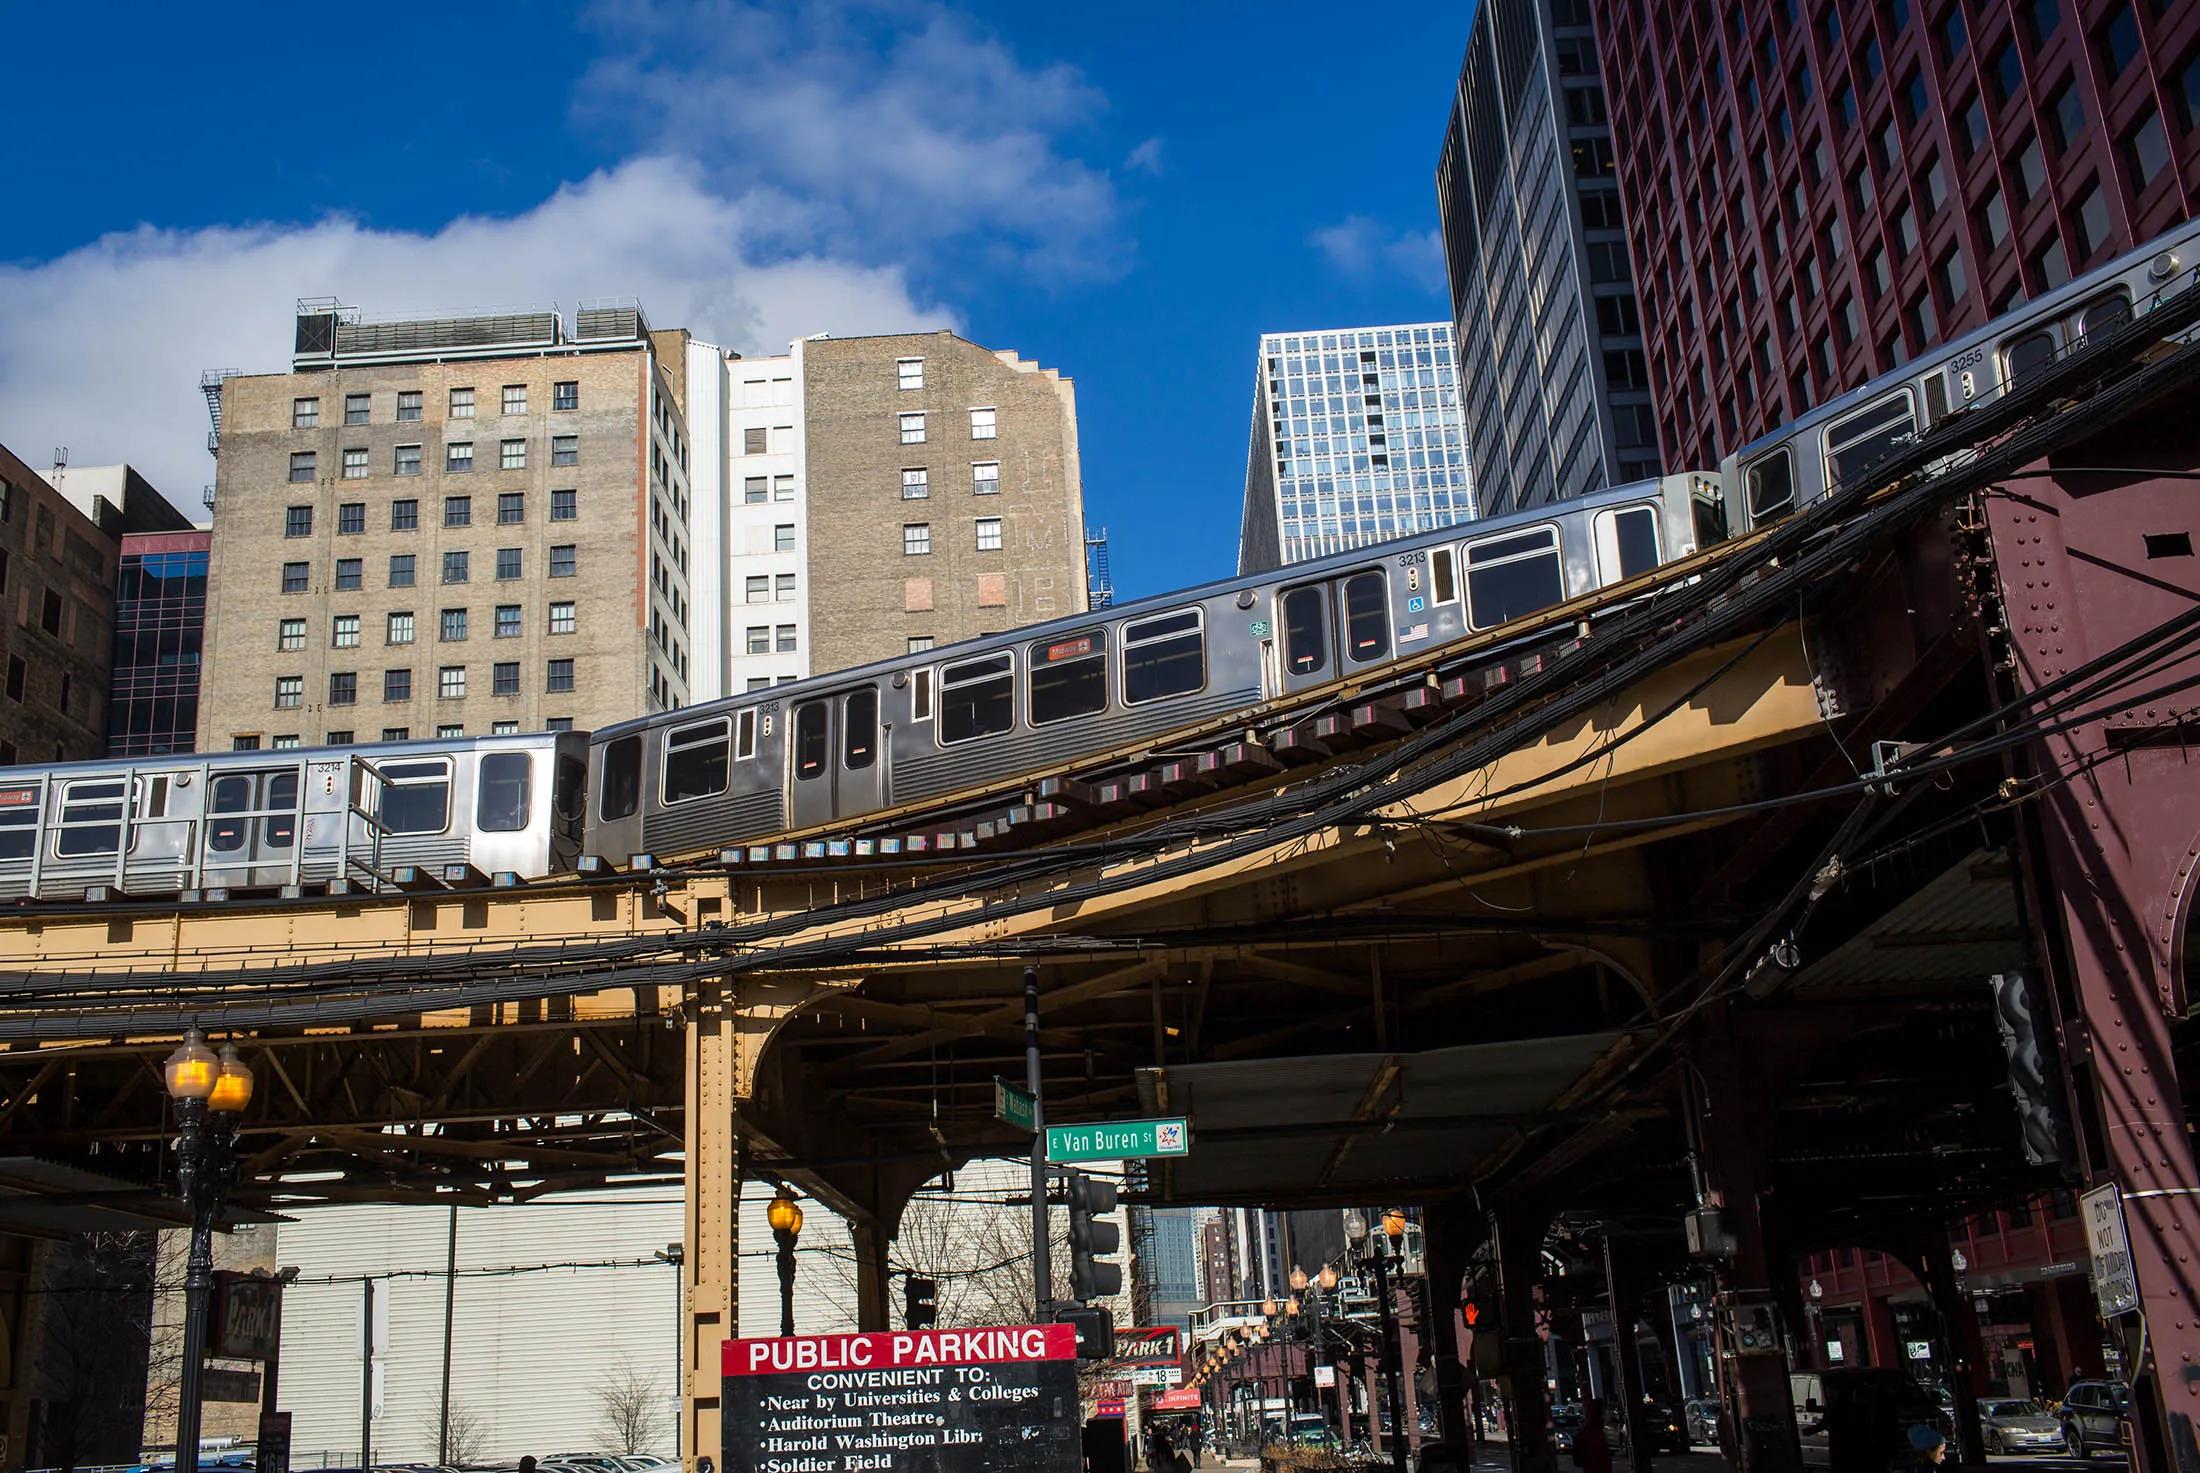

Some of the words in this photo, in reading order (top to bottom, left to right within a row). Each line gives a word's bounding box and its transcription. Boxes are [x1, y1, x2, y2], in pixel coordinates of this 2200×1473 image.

[1951, 349, 1983, 374] 3255
[1398, 551, 1426, 567] 3213
[760, 701, 780, 715] 3213
[317, 763, 341, 773] 3214
[1053, 1138, 1058, 1149] E
[1063, 1132, 1089, 1152] Van
[1095, 1131, 1138, 1150] Buren
[1143, 1132, 1152, 1143] St
[2097, 1226, 2114, 1250] NOT
[750, 1337, 873, 1371] PUBLIC
[893, 1329, 1046, 1364] PARKING
[807, 1369, 944, 1391] CONVENIENT
[955, 1367, 991, 1383] TO:
[1155, 1370, 1167, 1382] 18
[767, 1396, 809, 1411] Near
[816, 1394, 836, 1412] by
[844, 1388, 941, 1406] Universities
[948, 1387, 961, 1402] &
[968, 1384, 1039, 1402] Colleges
[1168, 1394, 1198, 1403] INFINITE
[768, 1414, 862, 1432] Auditorium
[869, 1411, 935, 1427] Theatre
[768, 1436, 828, 1452] Harold
[834, 1432, 935, 1450] Washington
[767, 1457, 836, 1473] Soldier
[844, 1454, 892, 1471] Field
